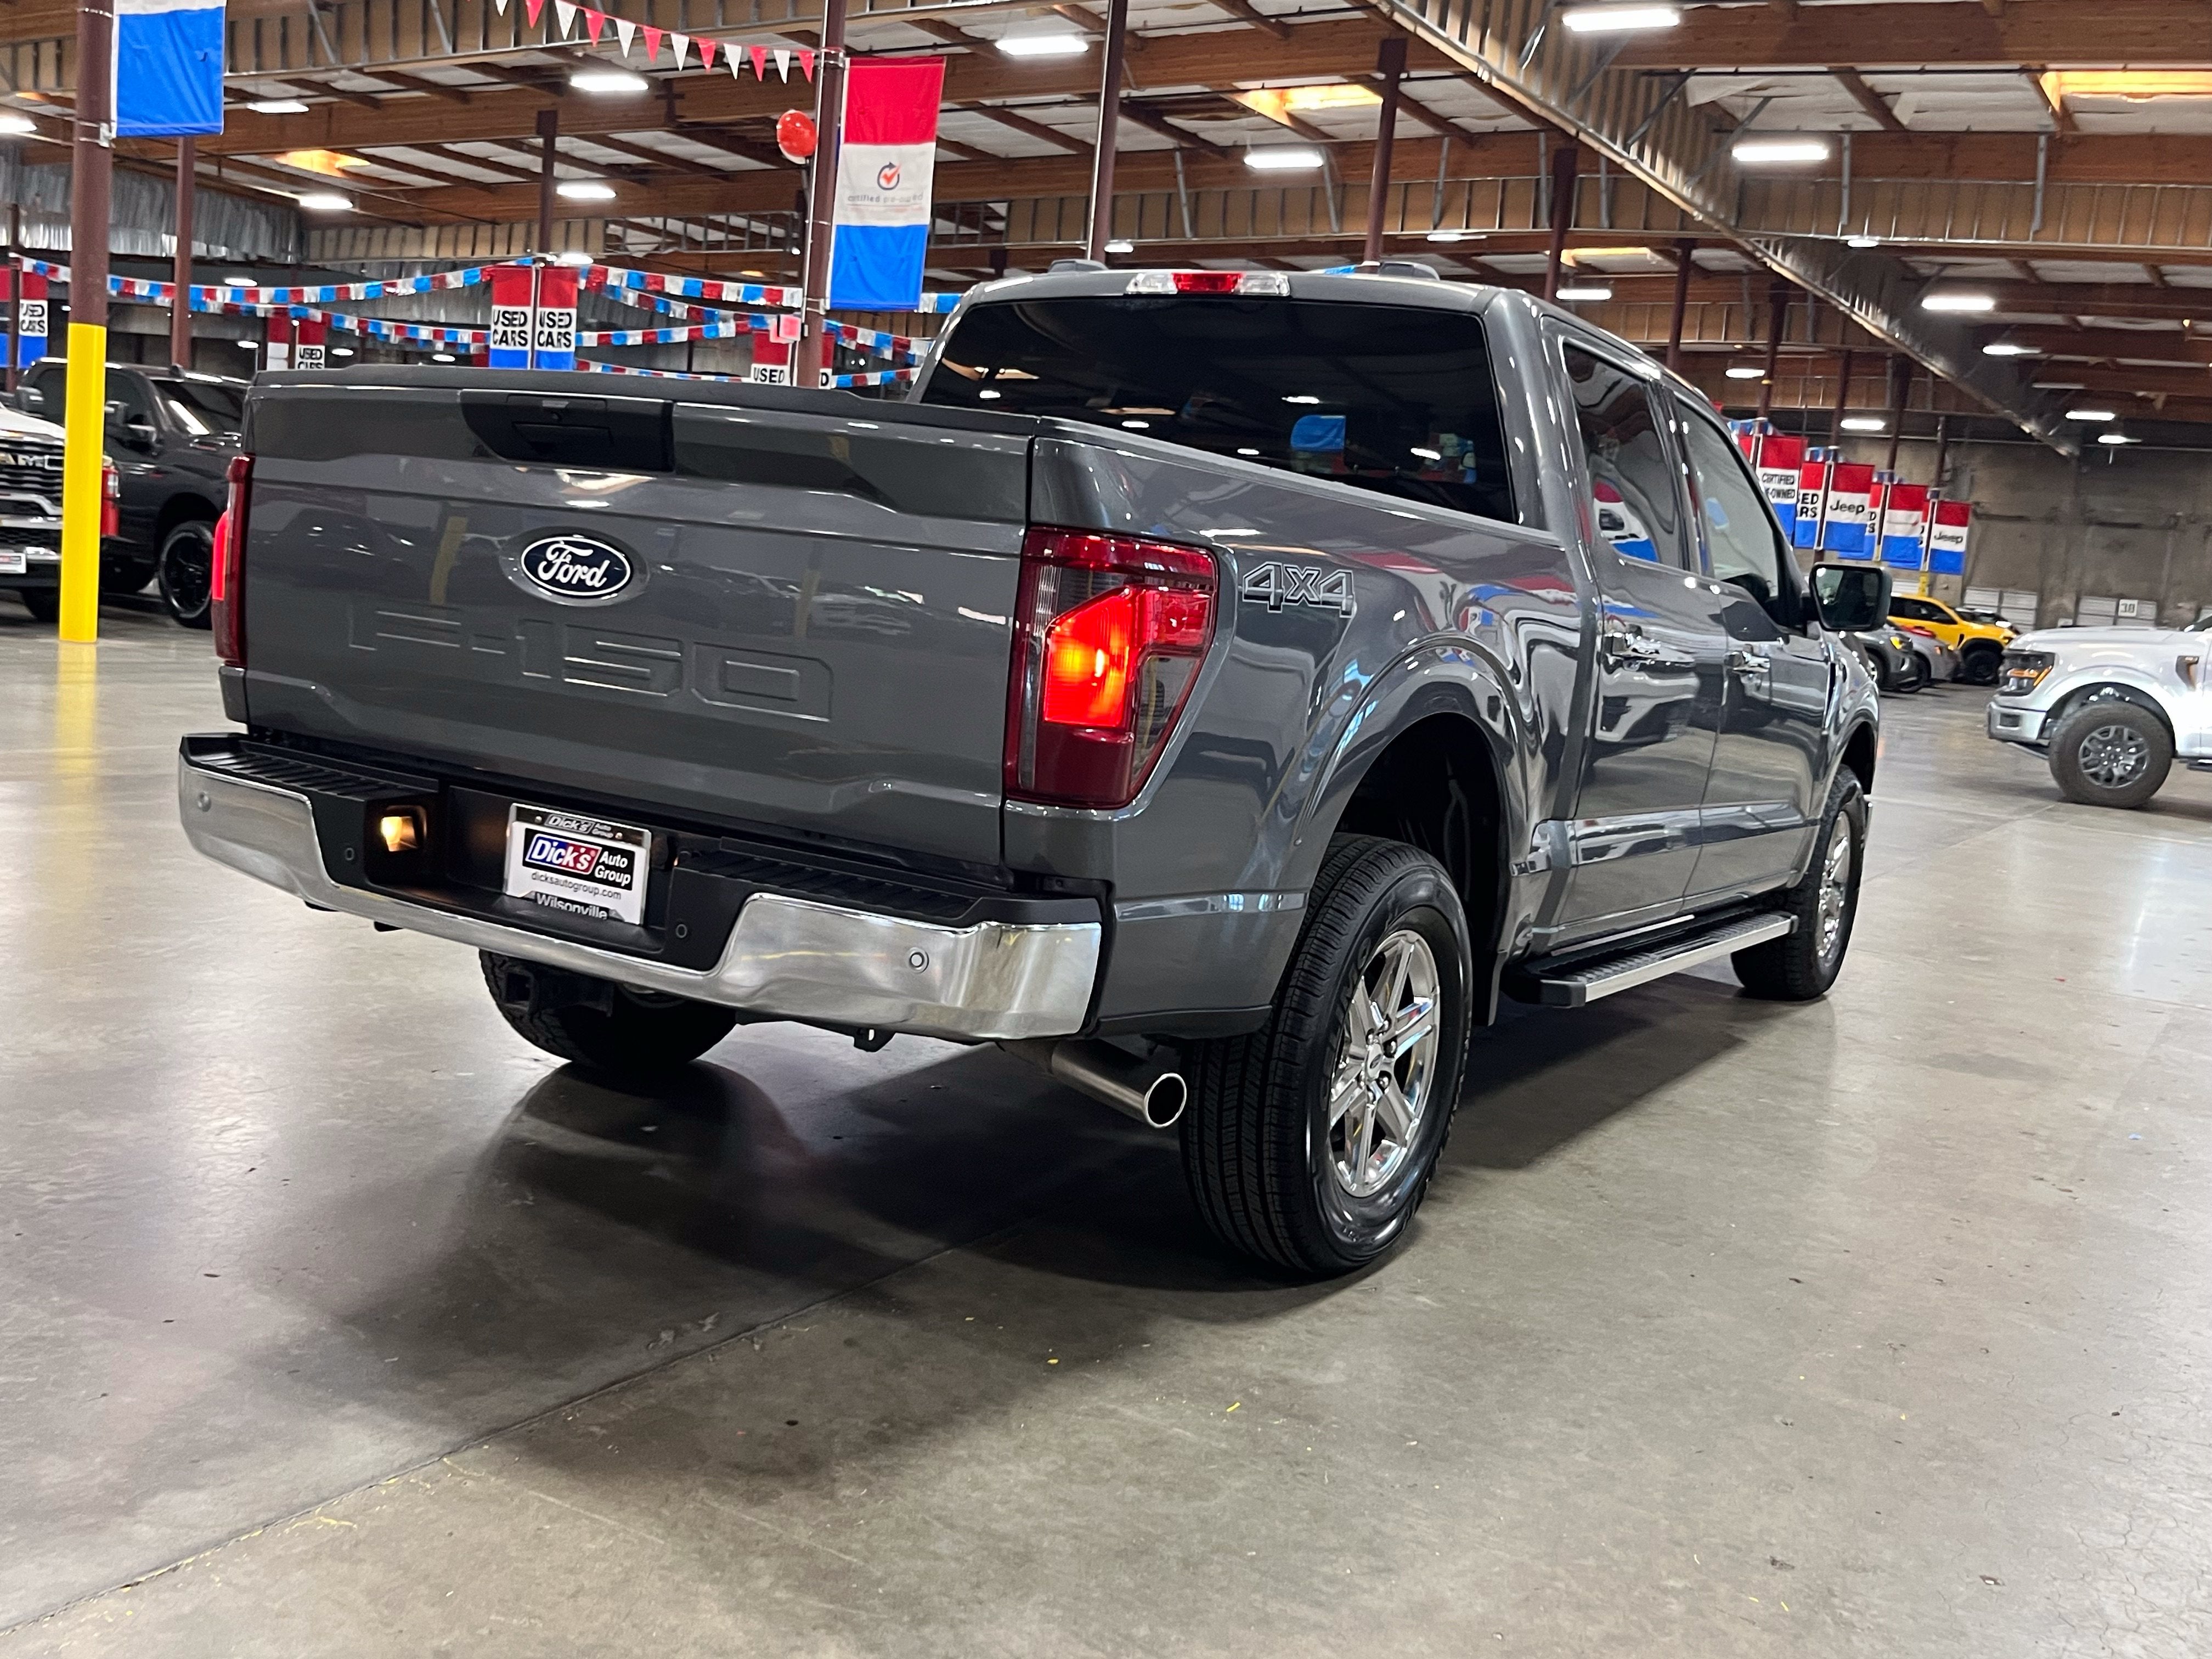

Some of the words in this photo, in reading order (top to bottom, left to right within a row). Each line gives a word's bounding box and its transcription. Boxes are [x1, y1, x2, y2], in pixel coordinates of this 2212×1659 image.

[493, 311, 527, 328] USED
[539, 311, 572, 328] USED
[493, 330, 528, 347] CARS
[537, 330, 572, 347] CARS
[753, 368, 785, 383] USED
[1830, 500, 1865, 515] Jeep
[538, 541, 610, 588] Ford
[348, 601, 834, 723] F-150
[531, 838, 592, 870] Dick's
[599, 851, 628, 868] Auto
[594, 865, 631, 887] Group
[531, 871, 621, 900] dicksautogroup.com
[536, 892, 608, 920] Wilsonville
